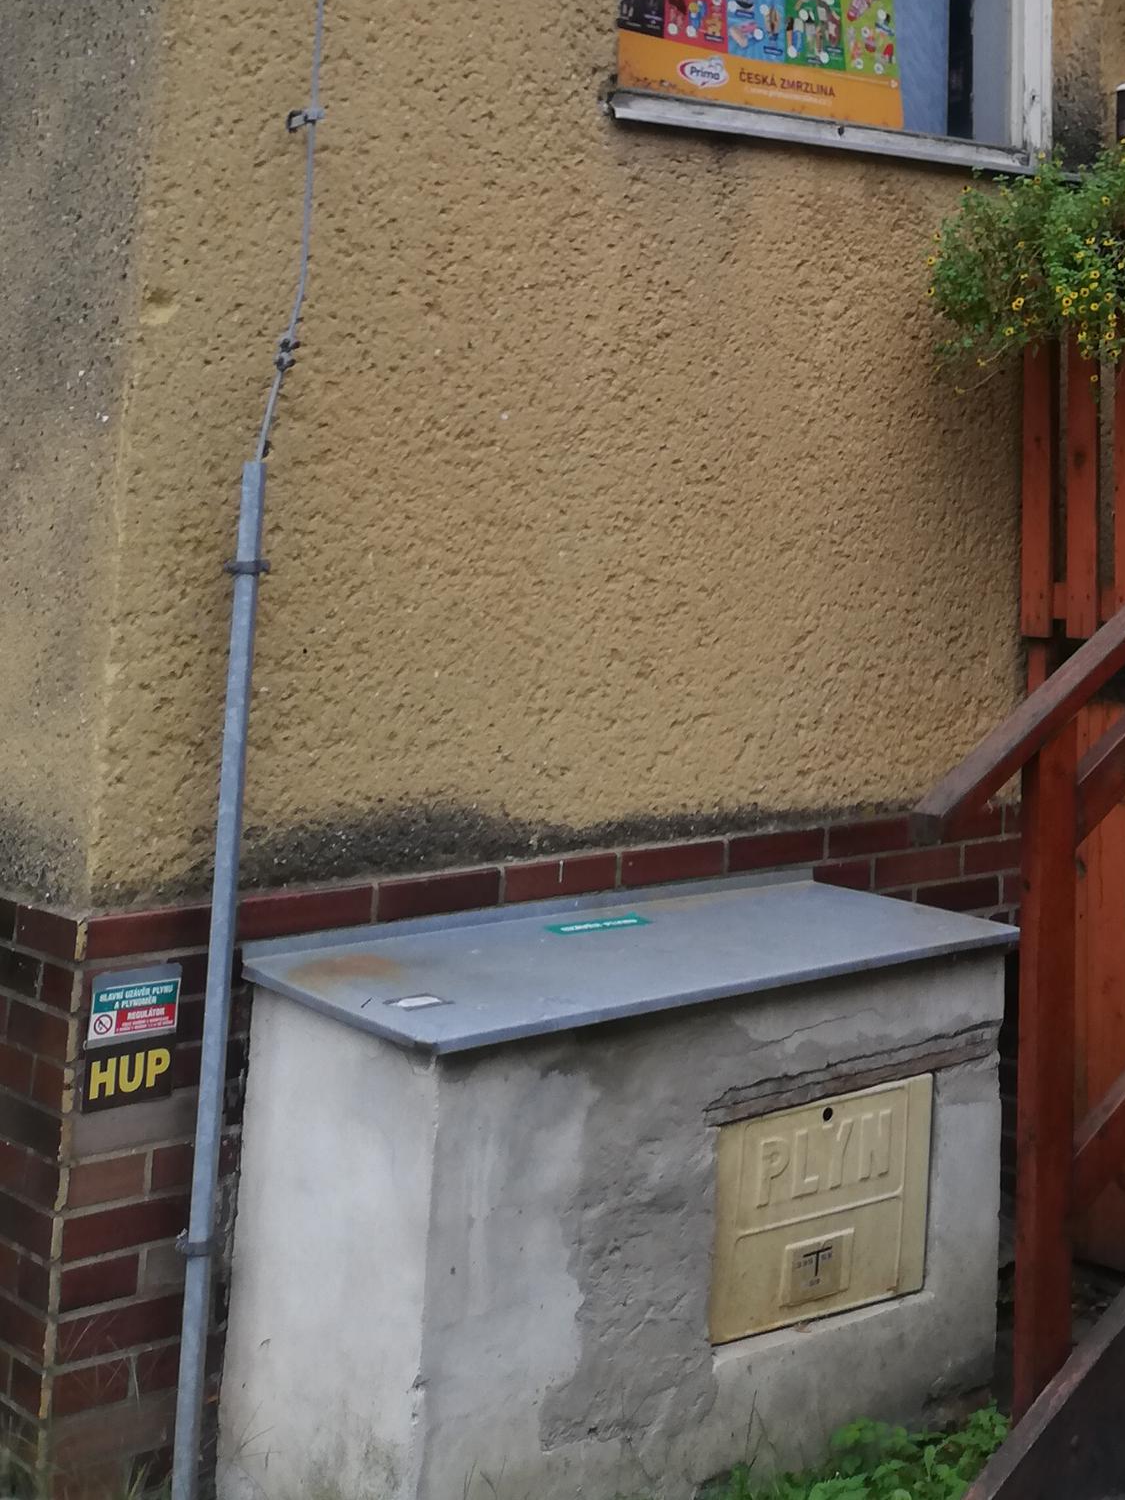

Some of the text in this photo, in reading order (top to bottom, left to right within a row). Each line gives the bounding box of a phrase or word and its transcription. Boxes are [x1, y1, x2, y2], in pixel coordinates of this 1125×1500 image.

[689, 66, 721, 83] Prima
[739, 67, 777, 89] ČESKÁ
[780, 77, 836, 98] ZMRZLINA
[89, 1048, 171, 1101] HUP
[756, 1109, 894, 1211] PLYN
